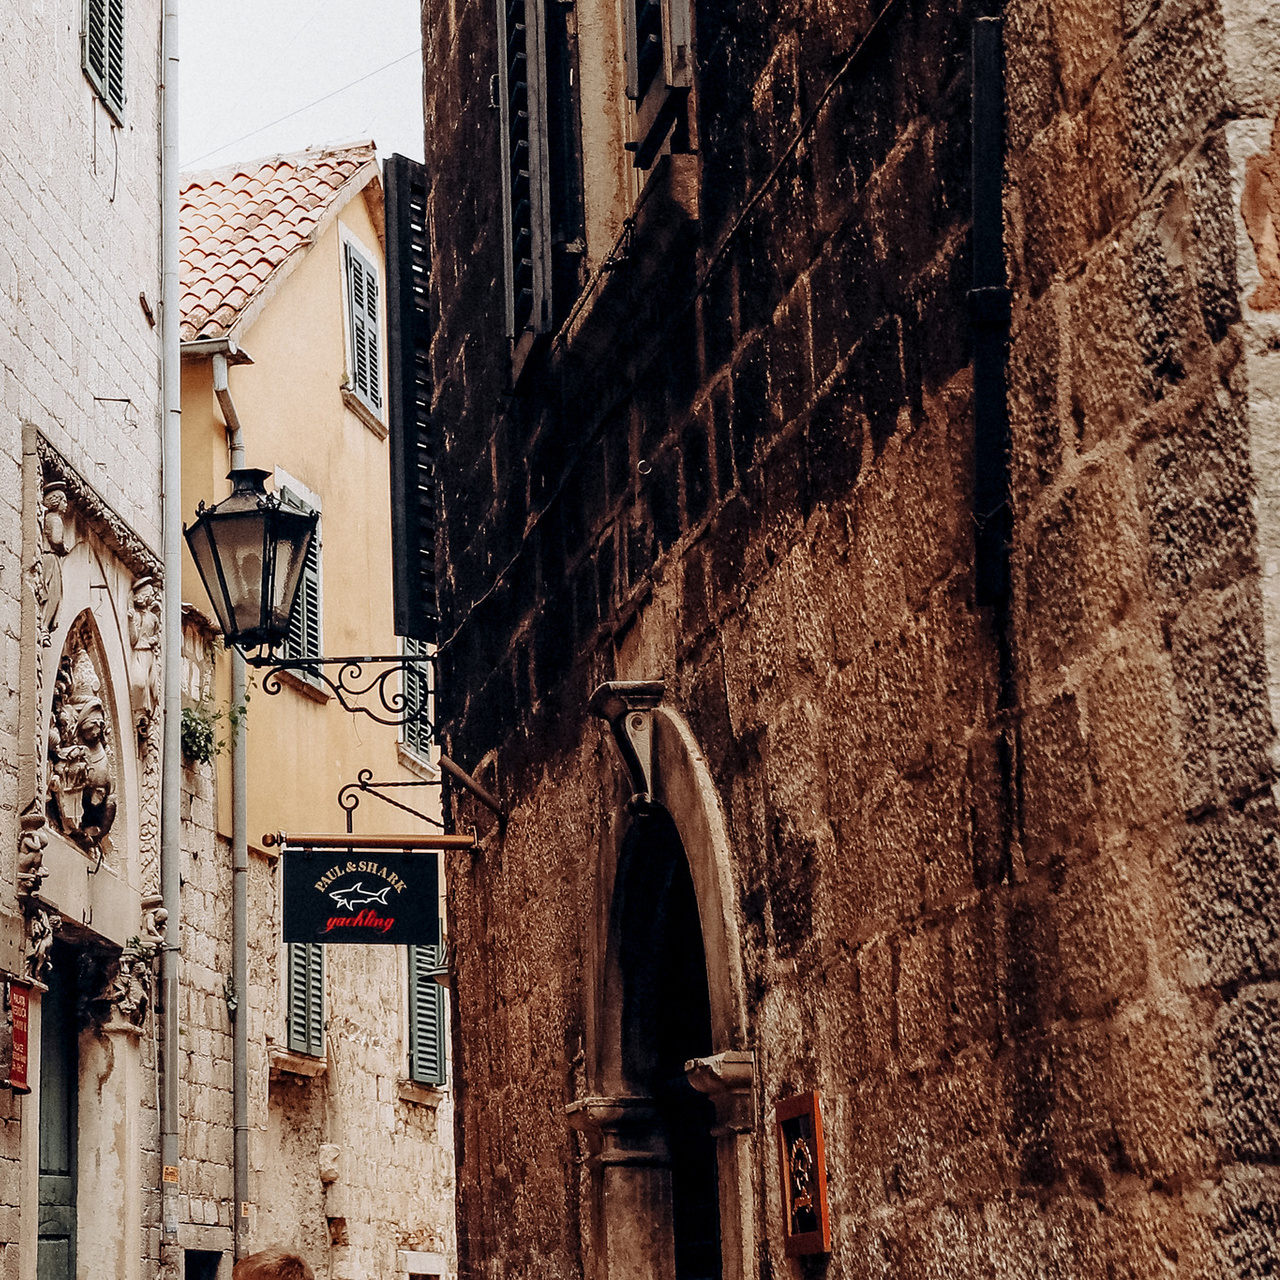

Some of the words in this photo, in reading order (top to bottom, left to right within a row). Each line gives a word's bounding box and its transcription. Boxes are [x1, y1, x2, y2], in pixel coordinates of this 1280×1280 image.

[314, 865, 345, 893] PAUL
[345, 861, 357, 873] &
[357, 860, 408, 894] SHARK
[323, 908, 395, 934] yachting
